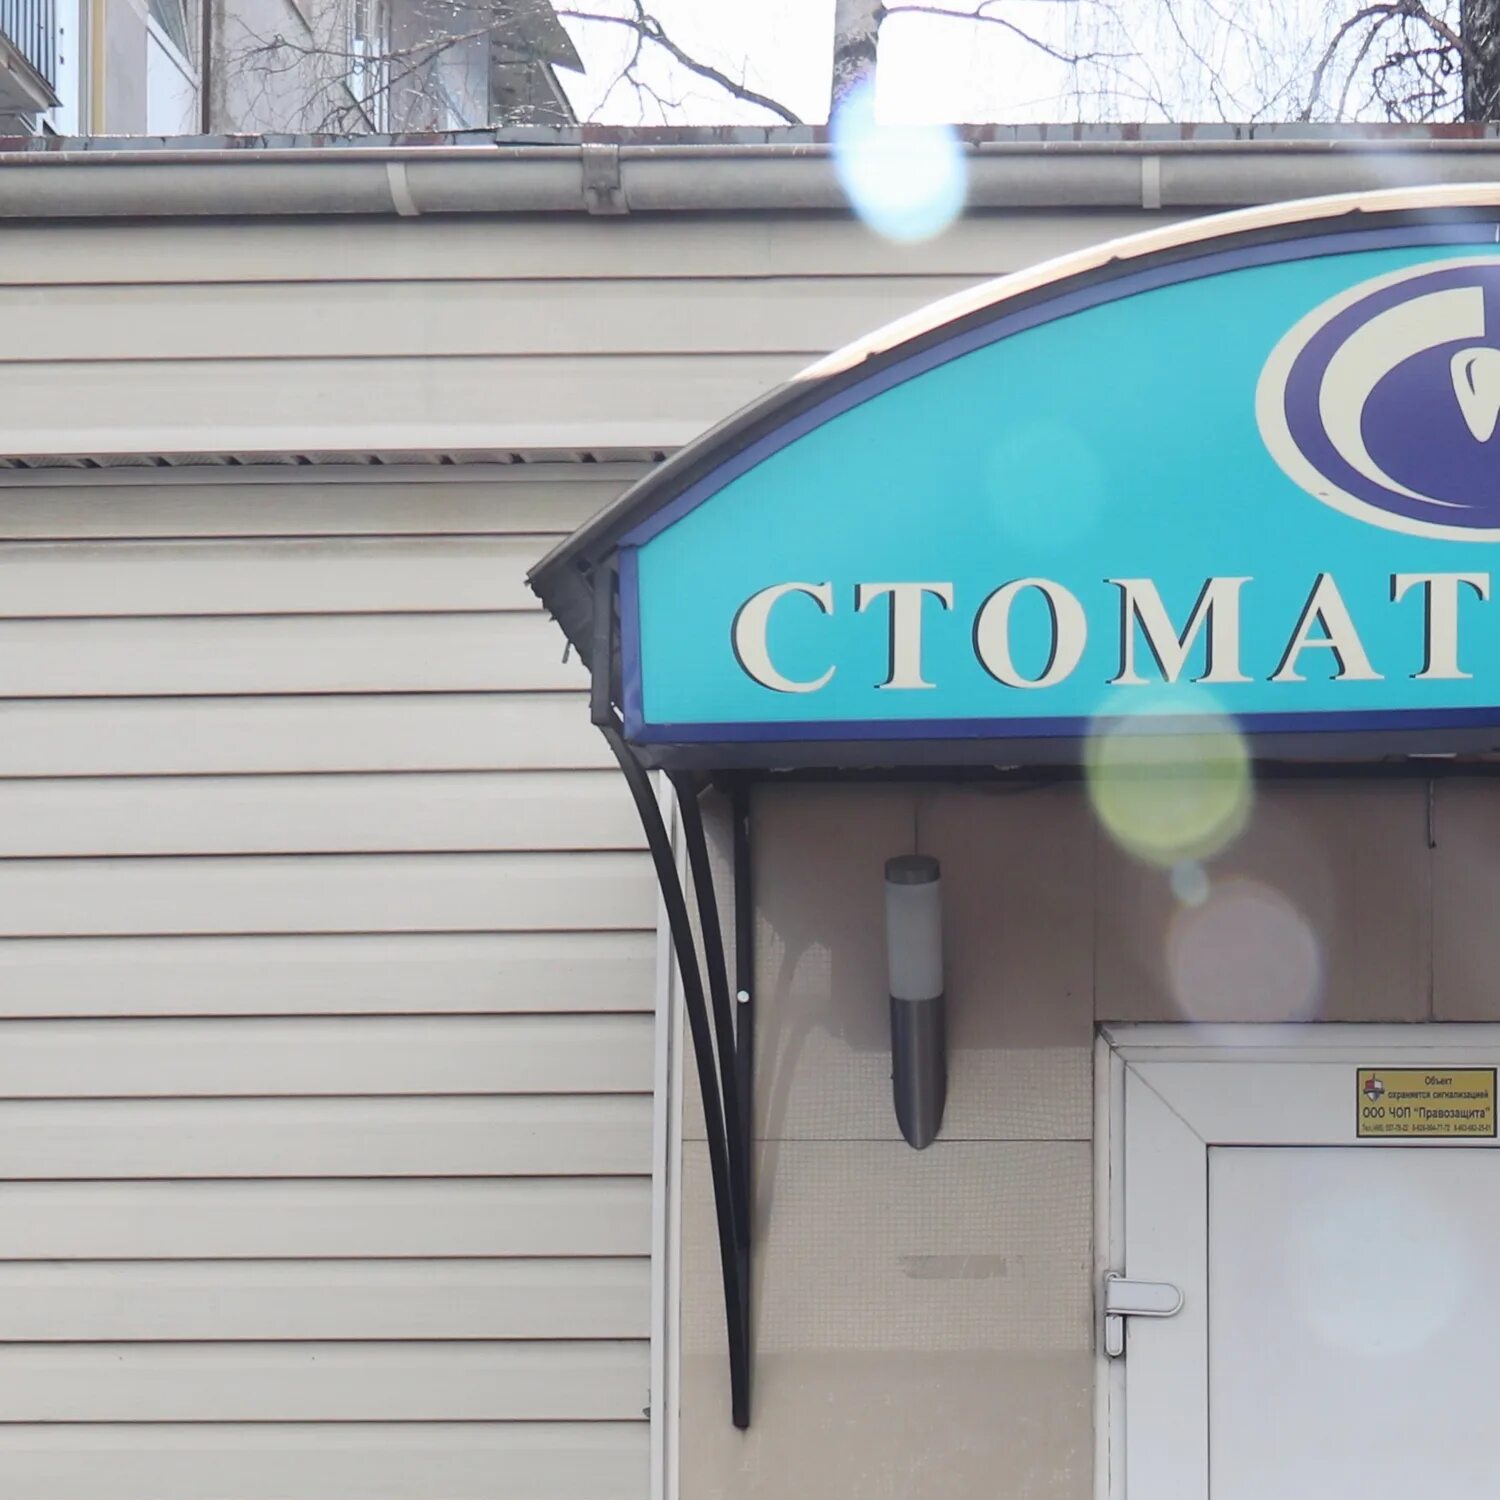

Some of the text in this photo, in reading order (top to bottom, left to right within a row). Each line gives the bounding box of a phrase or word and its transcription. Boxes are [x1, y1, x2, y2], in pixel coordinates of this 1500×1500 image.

[1424, 1075, 1453, 1085] Объект
[1363, 1107, 1385, 1118] ООО
[1389, 1107, 1411, 1118] ЧОП
